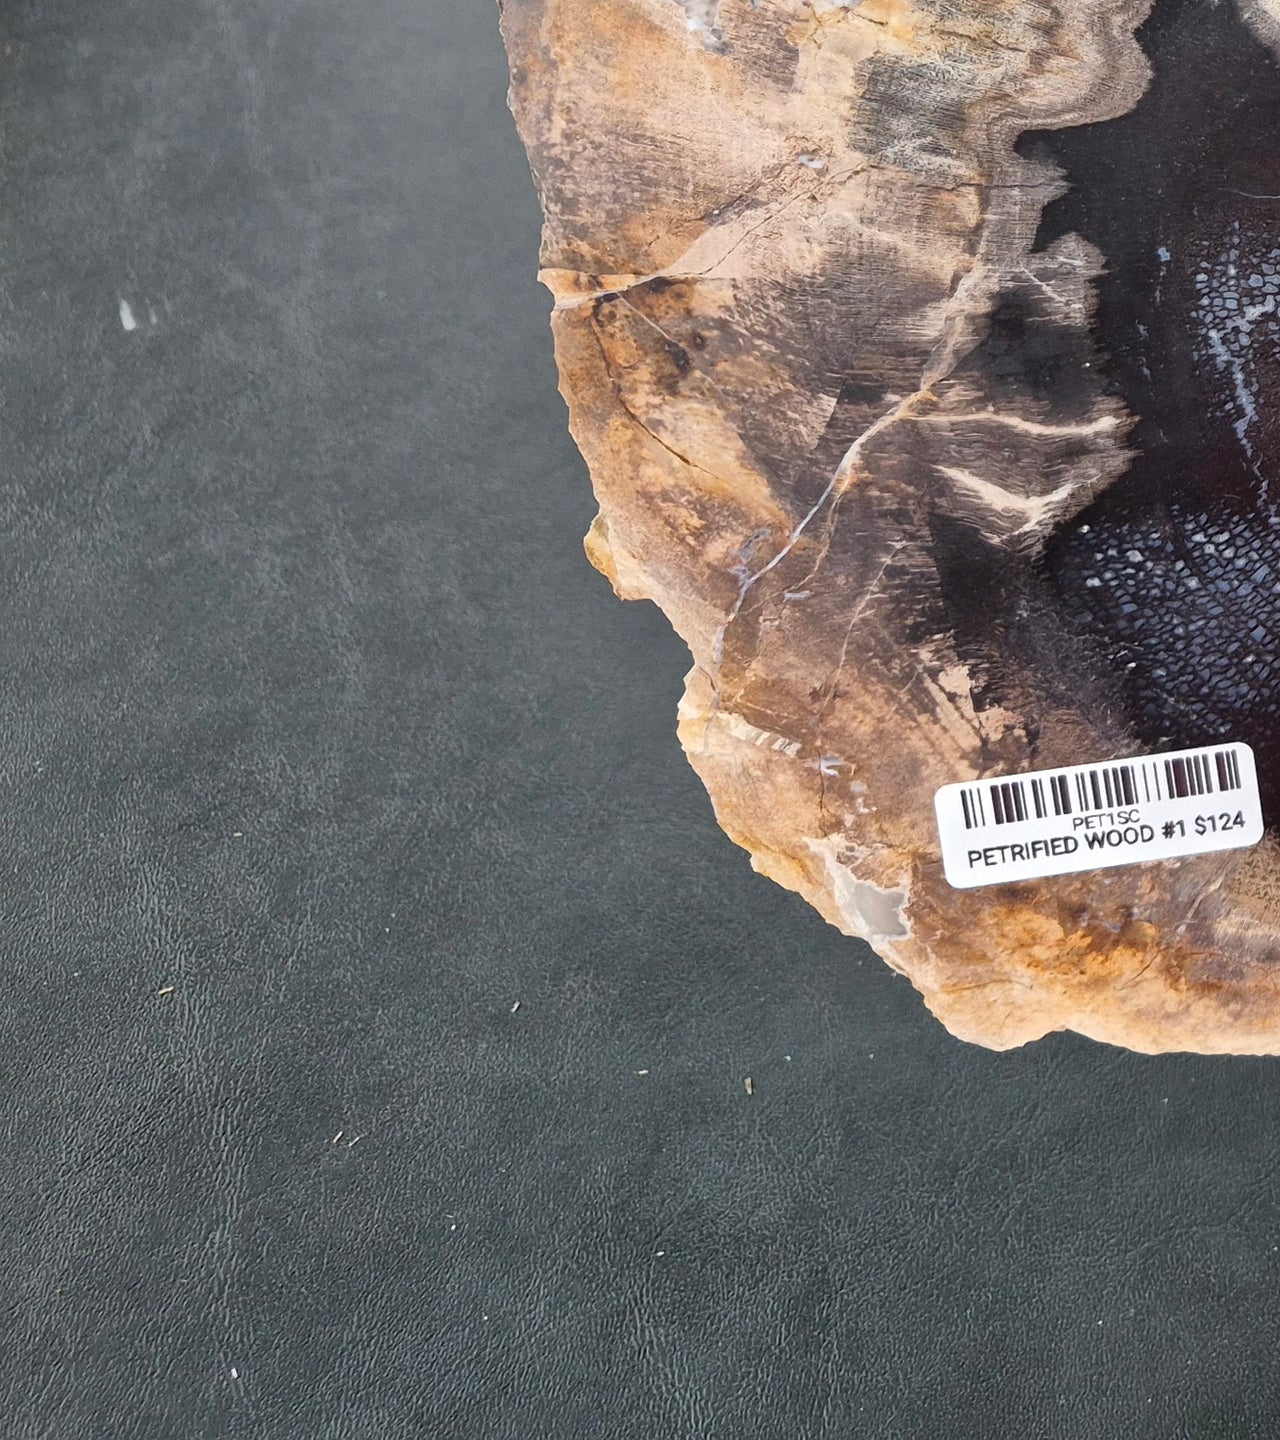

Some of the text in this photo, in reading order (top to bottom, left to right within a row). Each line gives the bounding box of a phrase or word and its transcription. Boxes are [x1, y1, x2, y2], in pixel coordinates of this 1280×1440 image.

[968, 810, 1246, 868] PETRIFIED WOOD #1 $124
[1072, 809, 1140, 831] PET1SC
